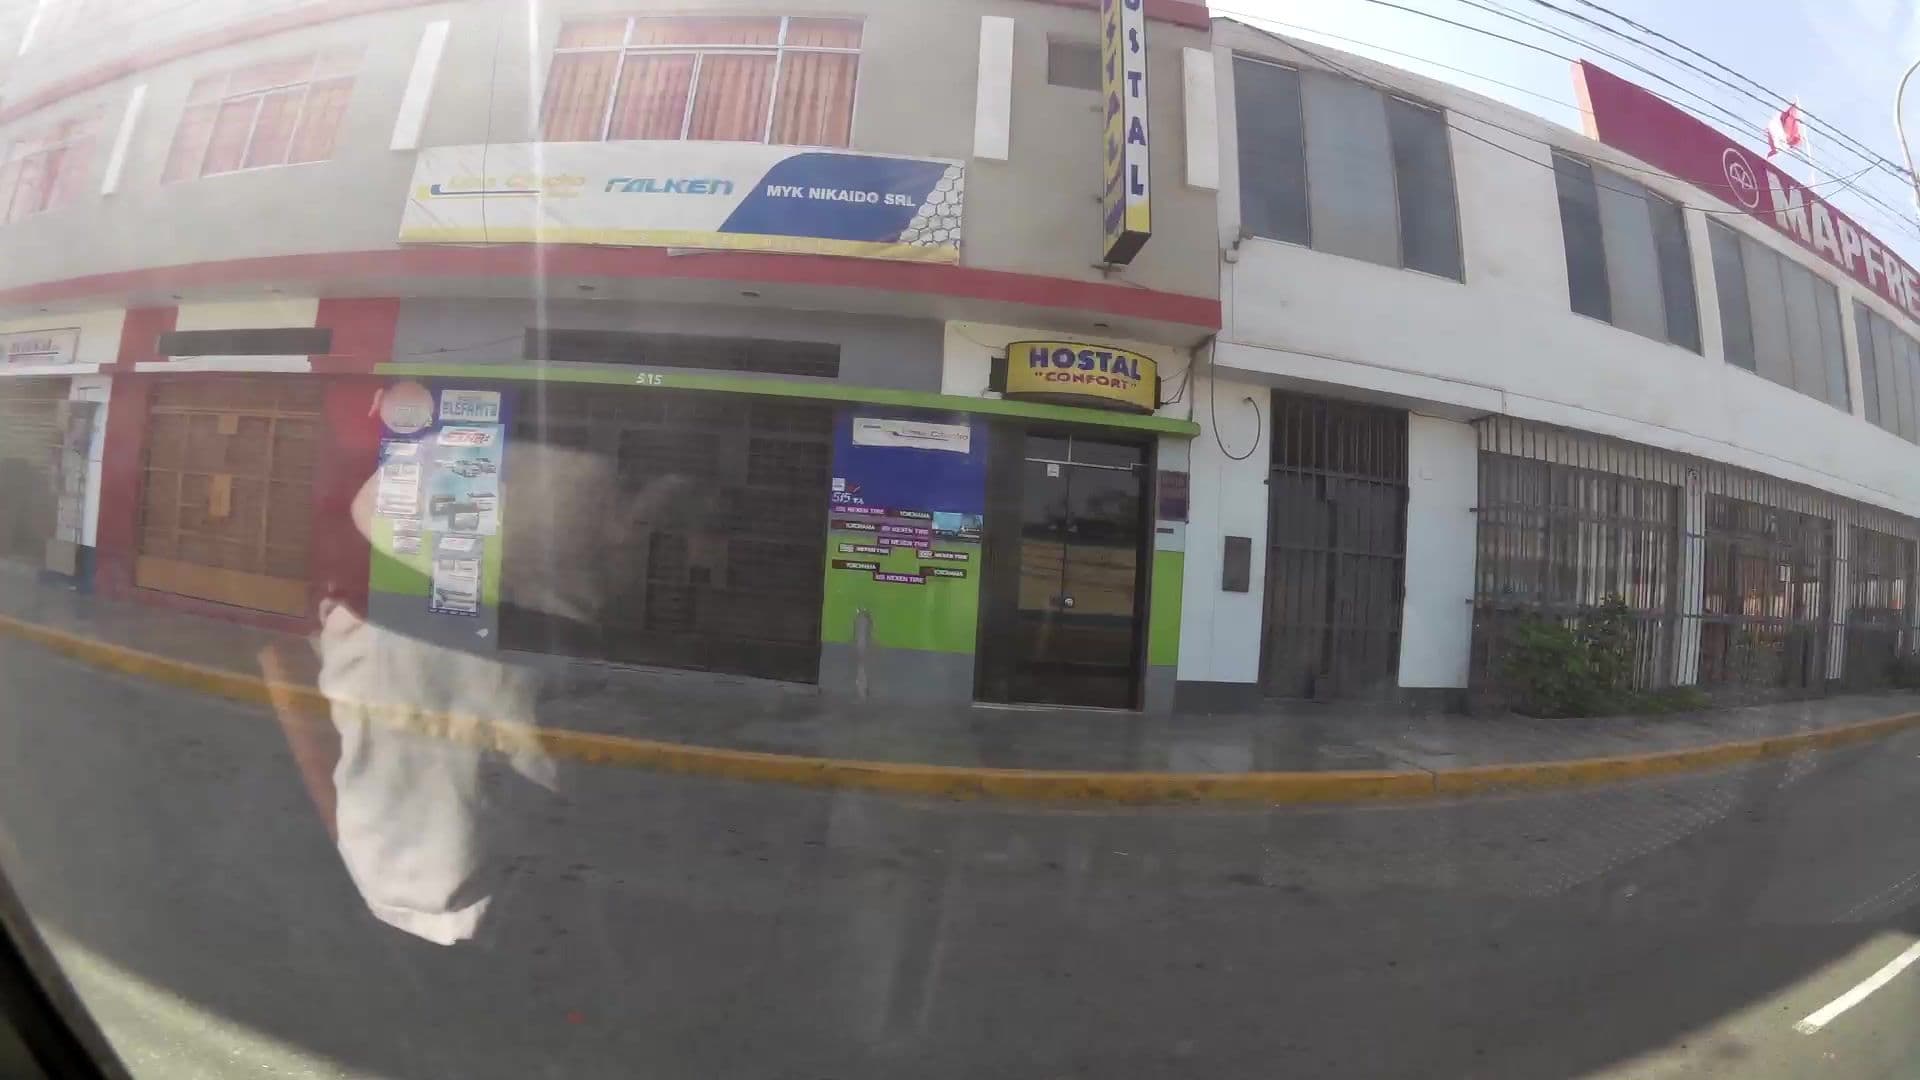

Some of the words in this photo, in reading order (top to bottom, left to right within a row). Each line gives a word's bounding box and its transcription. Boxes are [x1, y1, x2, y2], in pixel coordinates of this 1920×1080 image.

[767, 185, 804, 198] MYK
[809, 187, 879, 204] NIKAIDO
[883, 194, 916, 207] SRL
[1766, 169, 1920, 317] MAPFRE
[1030, 347, 1141, 381] HOSTAL
[635, 372, 664, 385] 515
